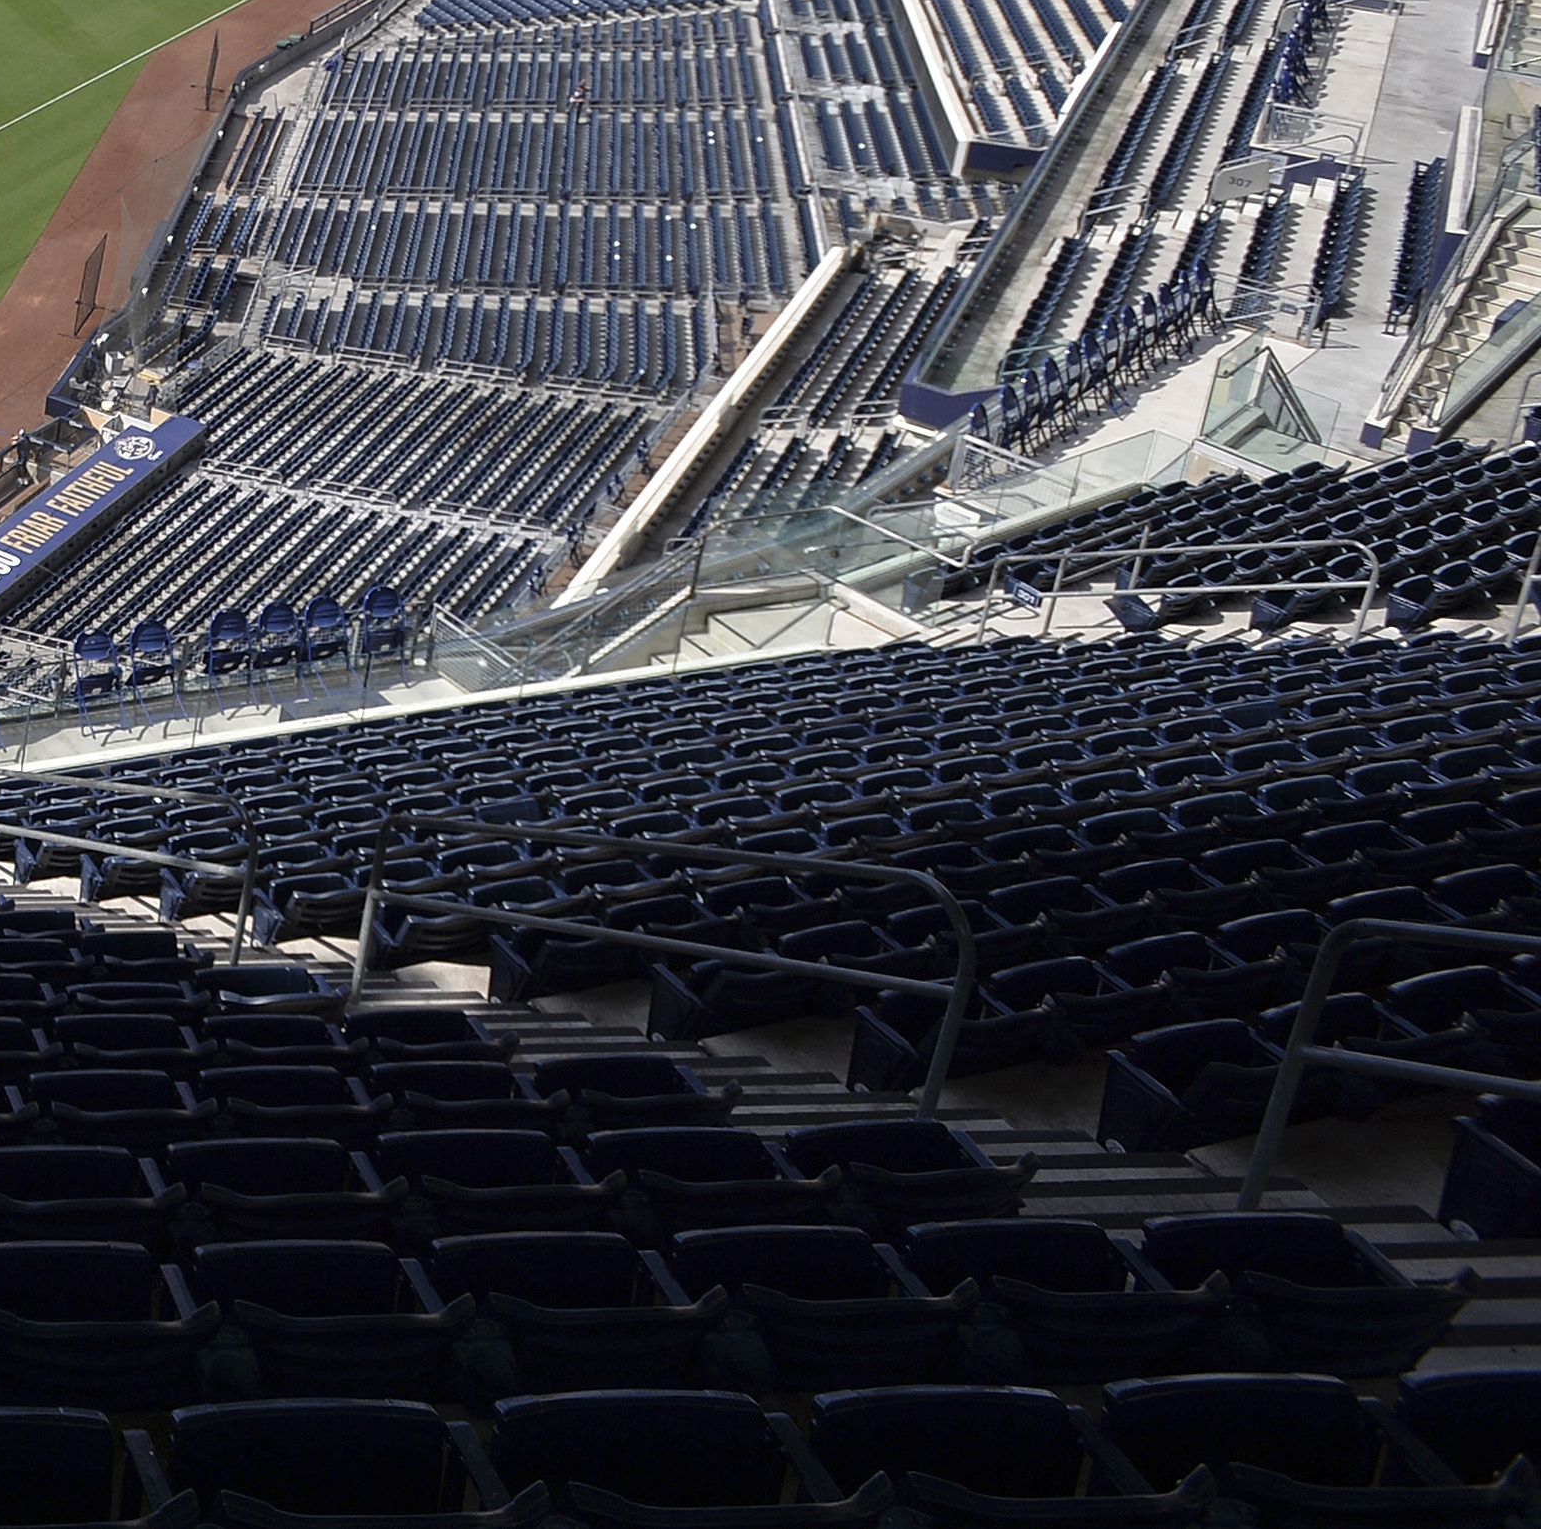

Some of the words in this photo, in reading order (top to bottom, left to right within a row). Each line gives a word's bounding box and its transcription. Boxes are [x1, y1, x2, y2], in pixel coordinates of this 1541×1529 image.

[1229, 176, 1252, 188] 307
[0, 511, 68, 554] FRIAR
[46, 461, 135, 517] FAITHFUL
